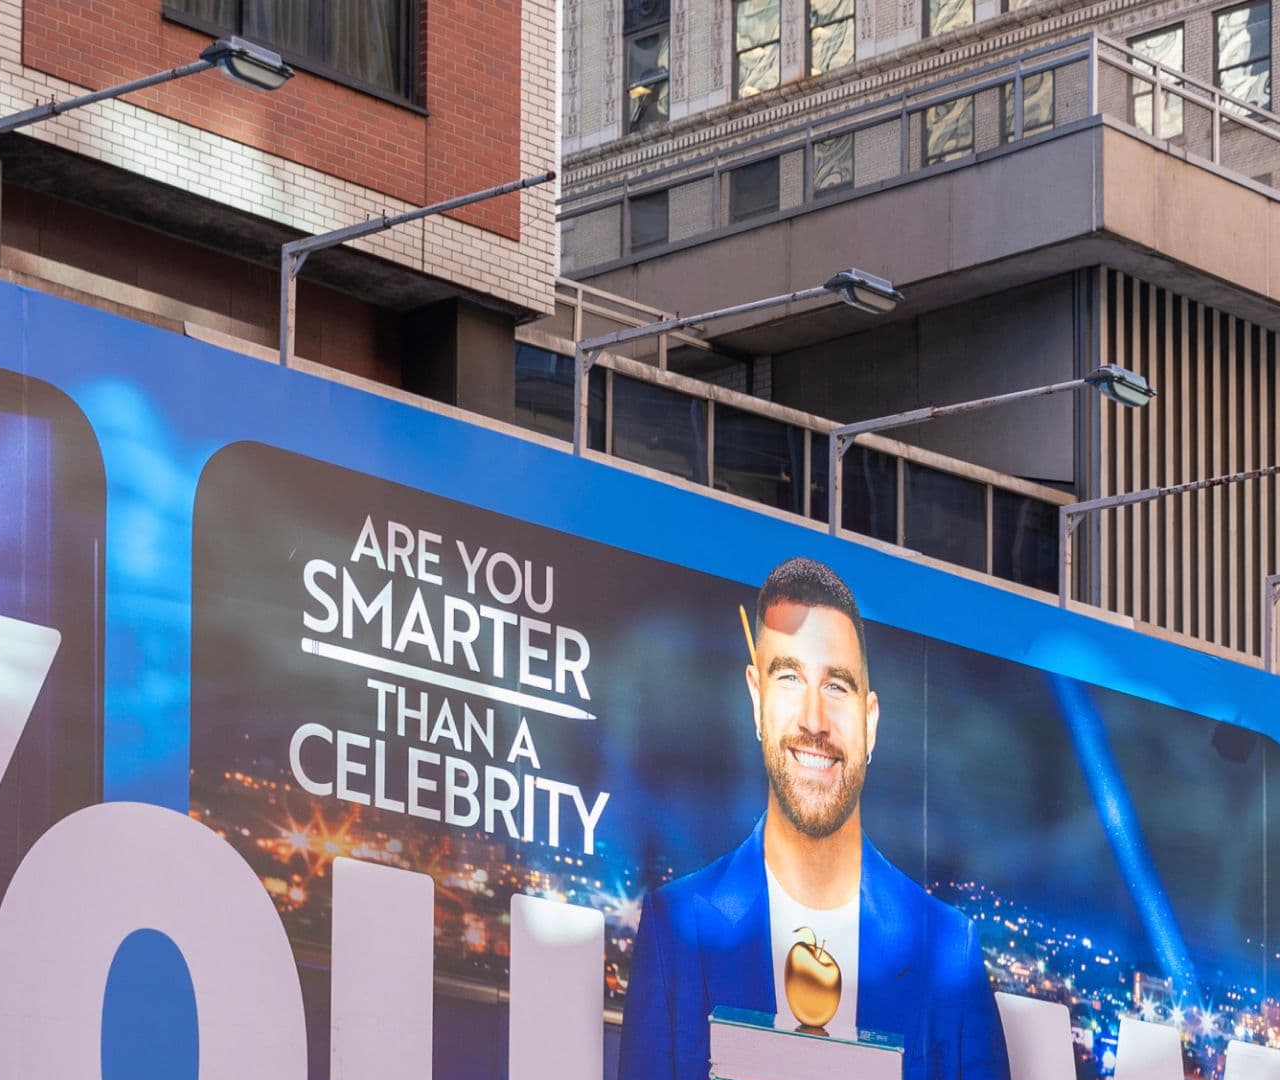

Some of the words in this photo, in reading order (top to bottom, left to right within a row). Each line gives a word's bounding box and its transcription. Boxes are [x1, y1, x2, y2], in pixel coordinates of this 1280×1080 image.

[350, 514, 443, 586] ARE
[455, 540, 554, 614] YOU
[303, 558, 591, 701] SMARTER
[367, 678, 494, 759] THAN
[506, 716, 541, 769] A
[289, 722, 610, 856] CELEBRITY
